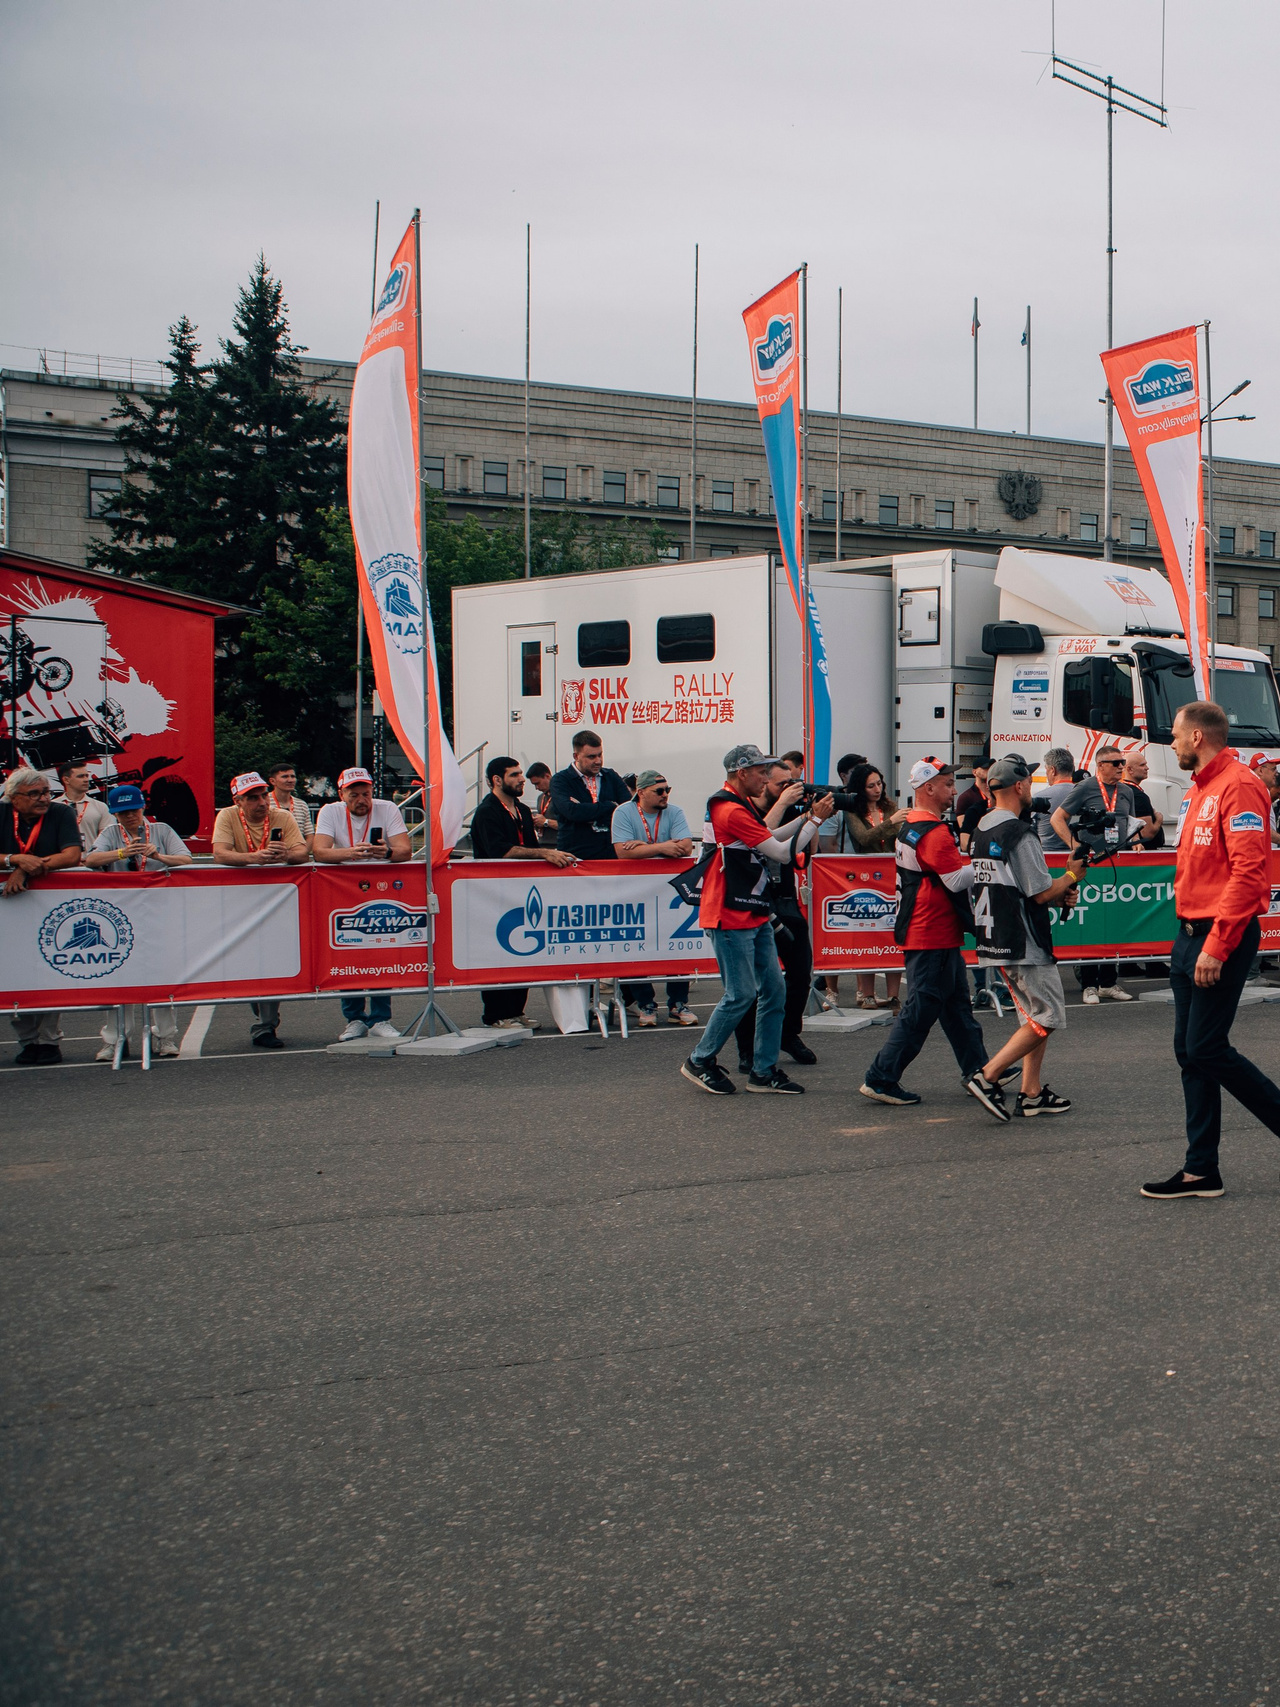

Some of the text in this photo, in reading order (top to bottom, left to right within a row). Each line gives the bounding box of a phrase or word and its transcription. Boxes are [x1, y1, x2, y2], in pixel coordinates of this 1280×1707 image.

[1074, 645, 1095, 653] WAY
[589, 672, 734, 700] SILK RALLY
[589, 698, 735, 725] WAY 丝绸之路拉力赛
[993, 733, 1052, 743] ORGANIZATION
[1194, 836, 1213, 846] WAY
[832, 904, 896, 913] SILK WAY
[974, 886, 994, 939] 4
[341, 916, 422, 928] SILK WAY
[548, 903, 645, 928] ГАЗПРОМ
[551, 929, 642, 943] ДОБЫЧА
[548, 942, 646, 955] ИРКУТСК
[668, 940, 703, 951] 2000
[53, 952, 121, 965] CAMF
